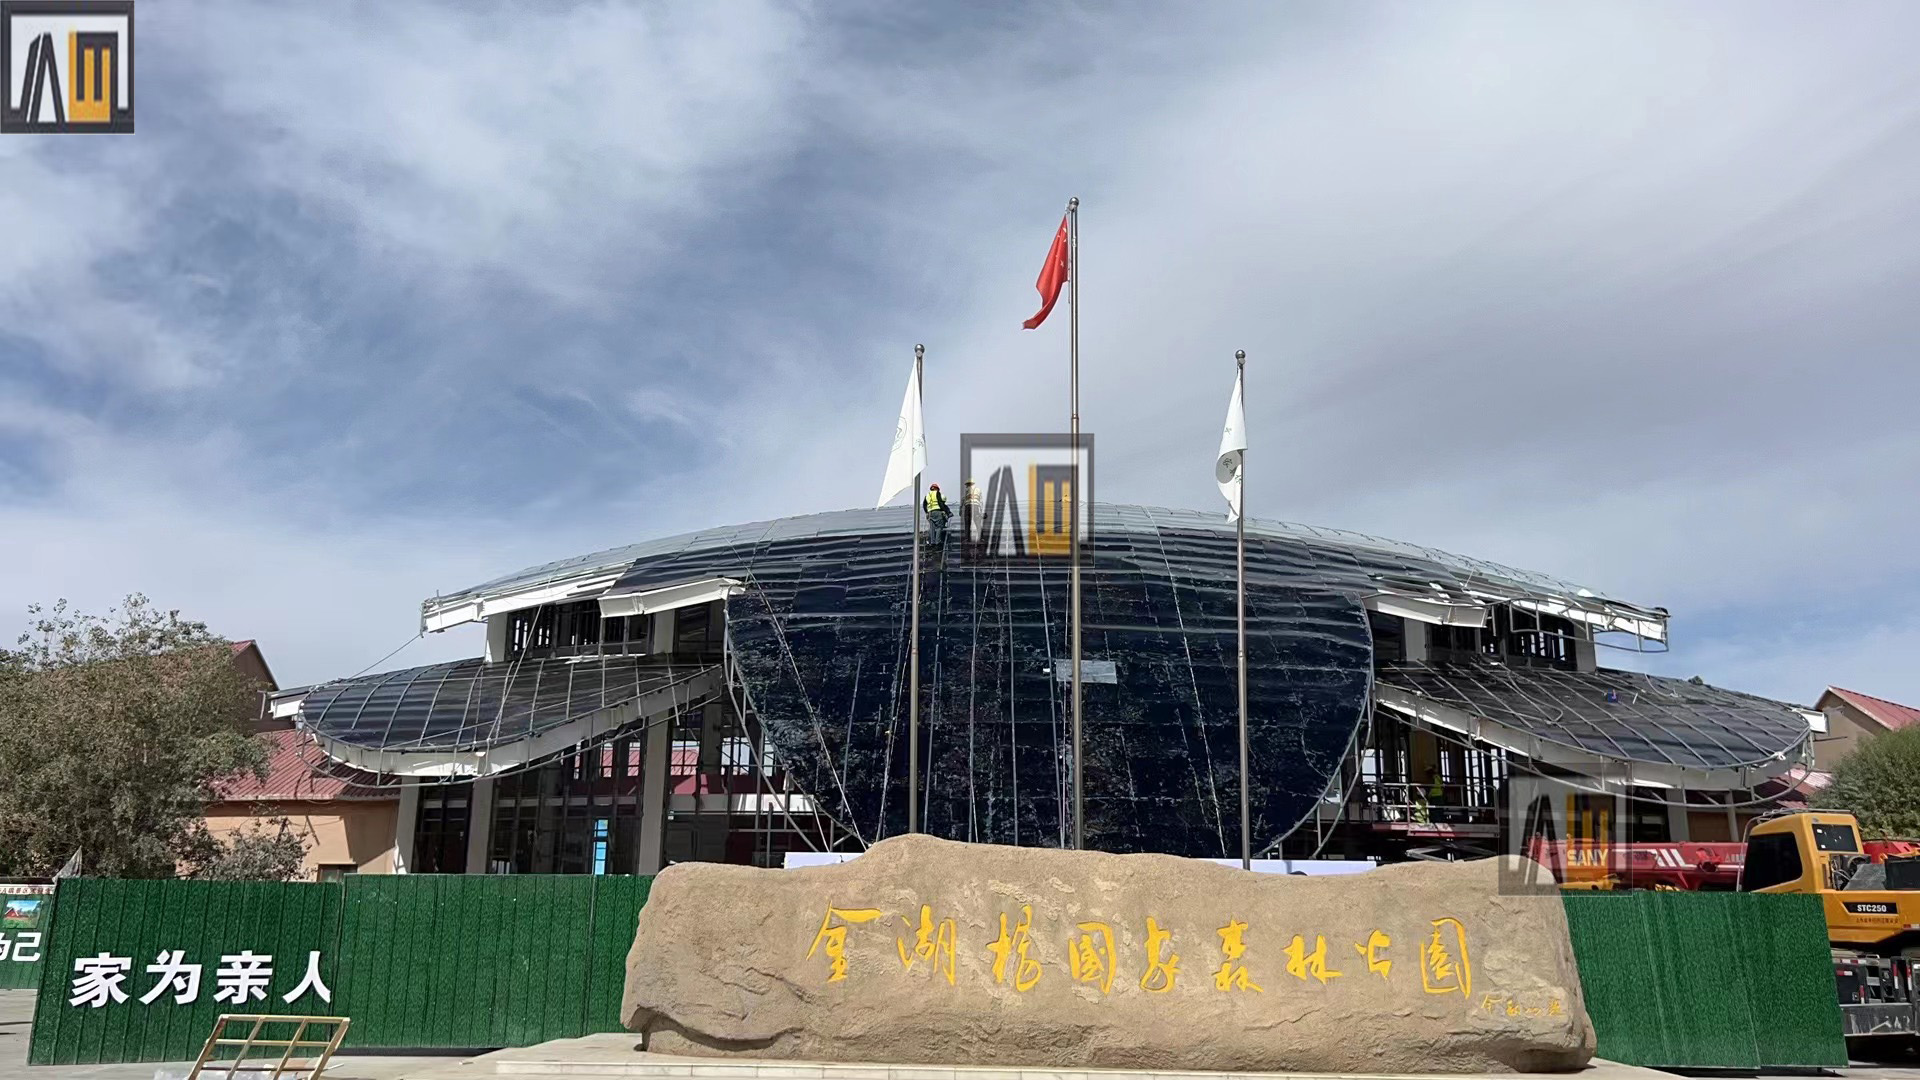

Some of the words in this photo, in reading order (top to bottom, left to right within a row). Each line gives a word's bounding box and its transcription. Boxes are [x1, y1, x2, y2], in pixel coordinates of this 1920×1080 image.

[1567, 849, 1608, 866] SANY
[1857, 904, 1887, 912] STC250
[69, 949, 331, 1008] 家为亲人
